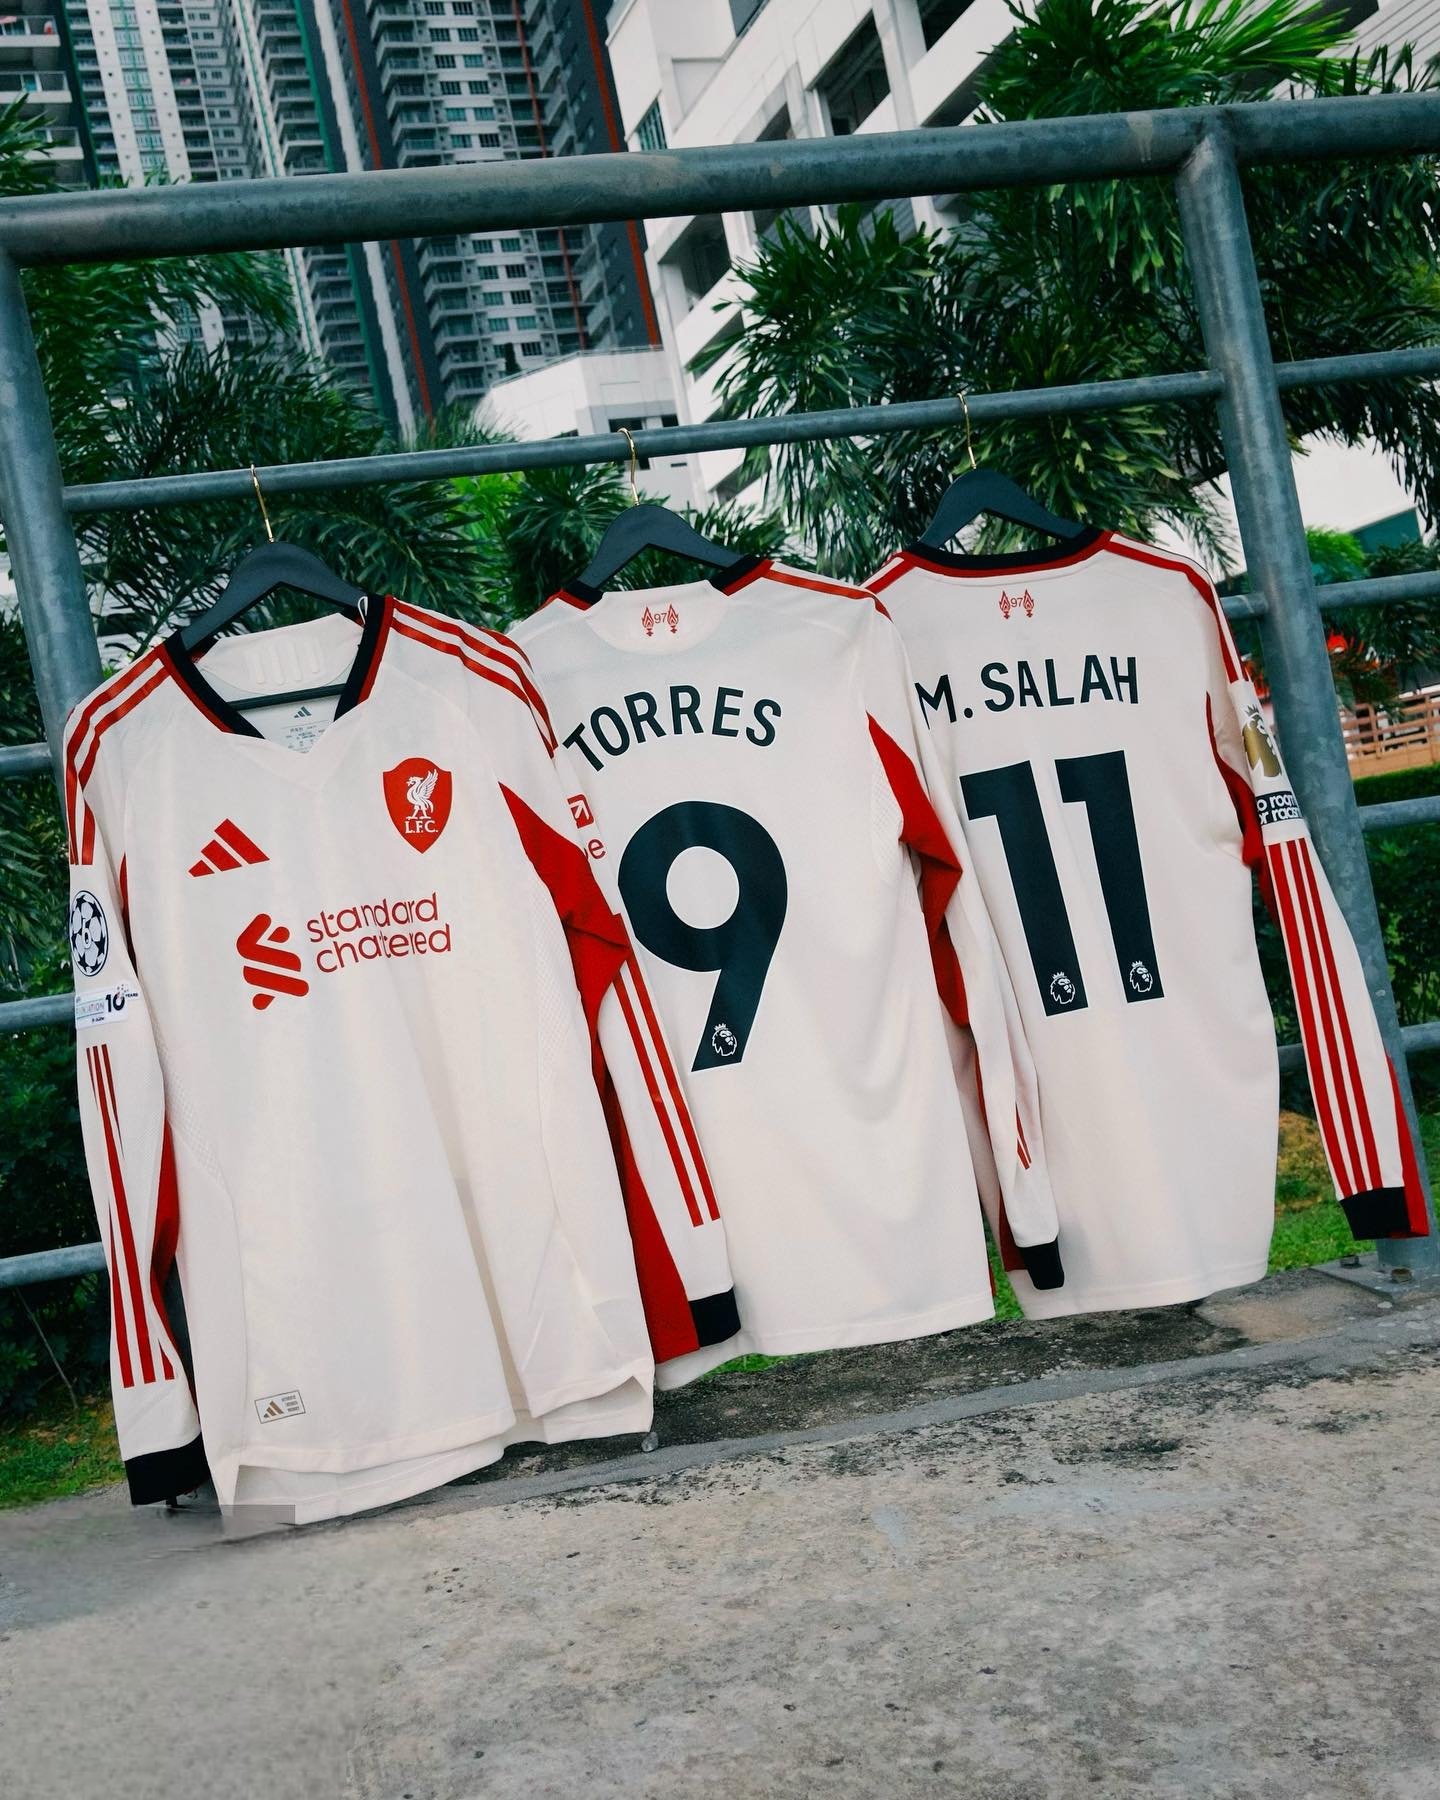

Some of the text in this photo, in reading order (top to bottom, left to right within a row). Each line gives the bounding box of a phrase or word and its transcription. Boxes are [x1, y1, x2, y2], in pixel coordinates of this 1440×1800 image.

[653, 611, 668, 624] 97
[1010, 597, 1023, 608] 97
[562, 684, 782, 773] TORRES
[959, 749, 1165, 1017] 11
[306, 891, 439, 943] standard
[617, 800, 788, 1073] 9
[105, 991, 126, 1013] 10
